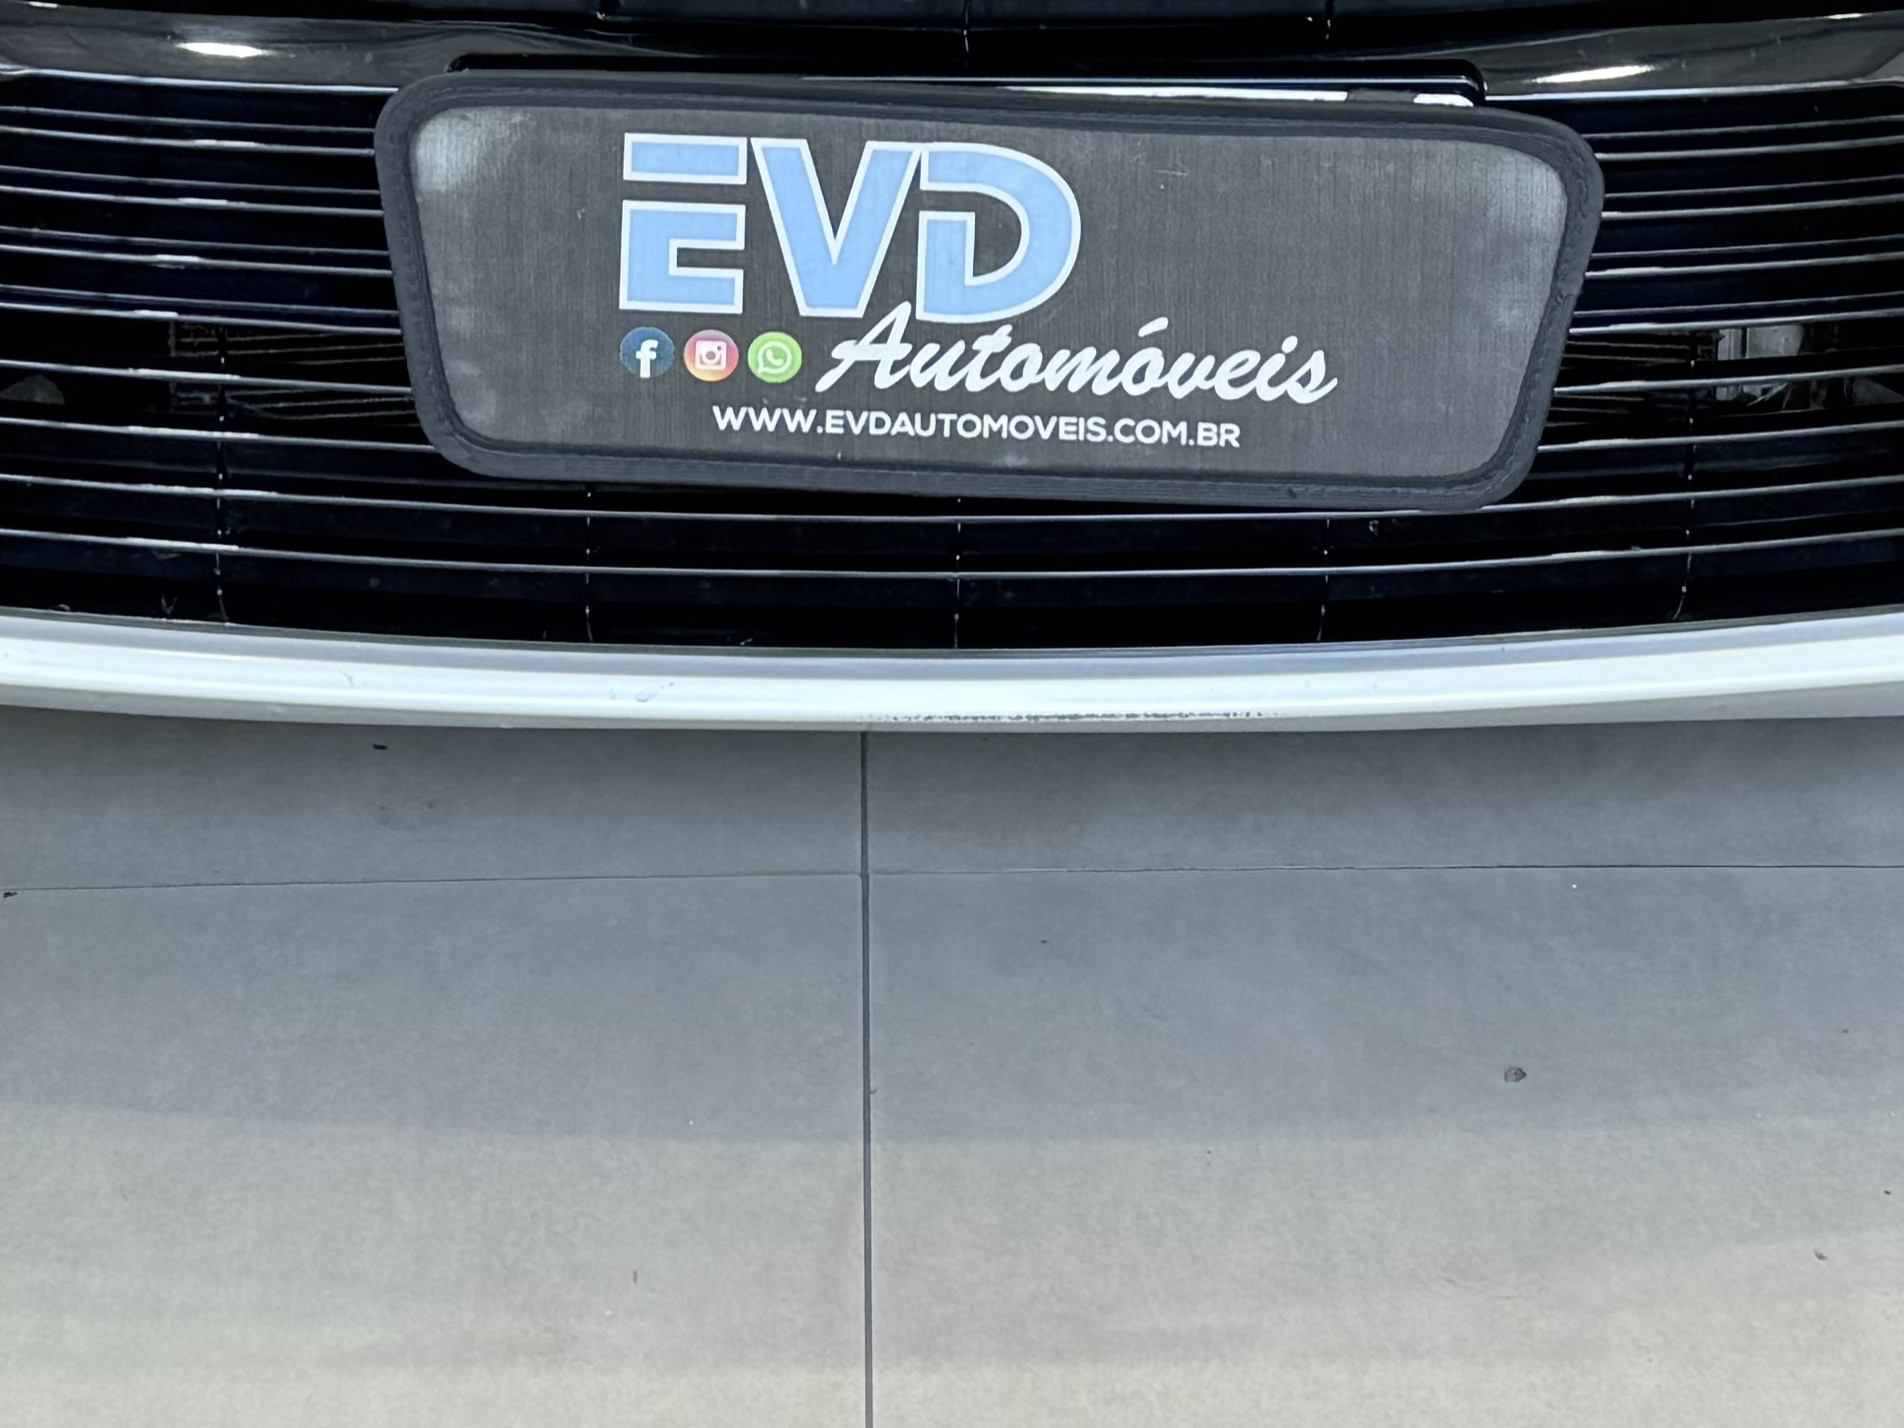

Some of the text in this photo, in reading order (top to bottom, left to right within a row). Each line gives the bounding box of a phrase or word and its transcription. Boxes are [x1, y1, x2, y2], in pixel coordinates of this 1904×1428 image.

[618, 131, 1082, 325] EVD
[814, 300, 1339, 405] Automóveis
[711, 404, 1241, 448] WWW.EVDAUTOMOVEIS.COM.BR
